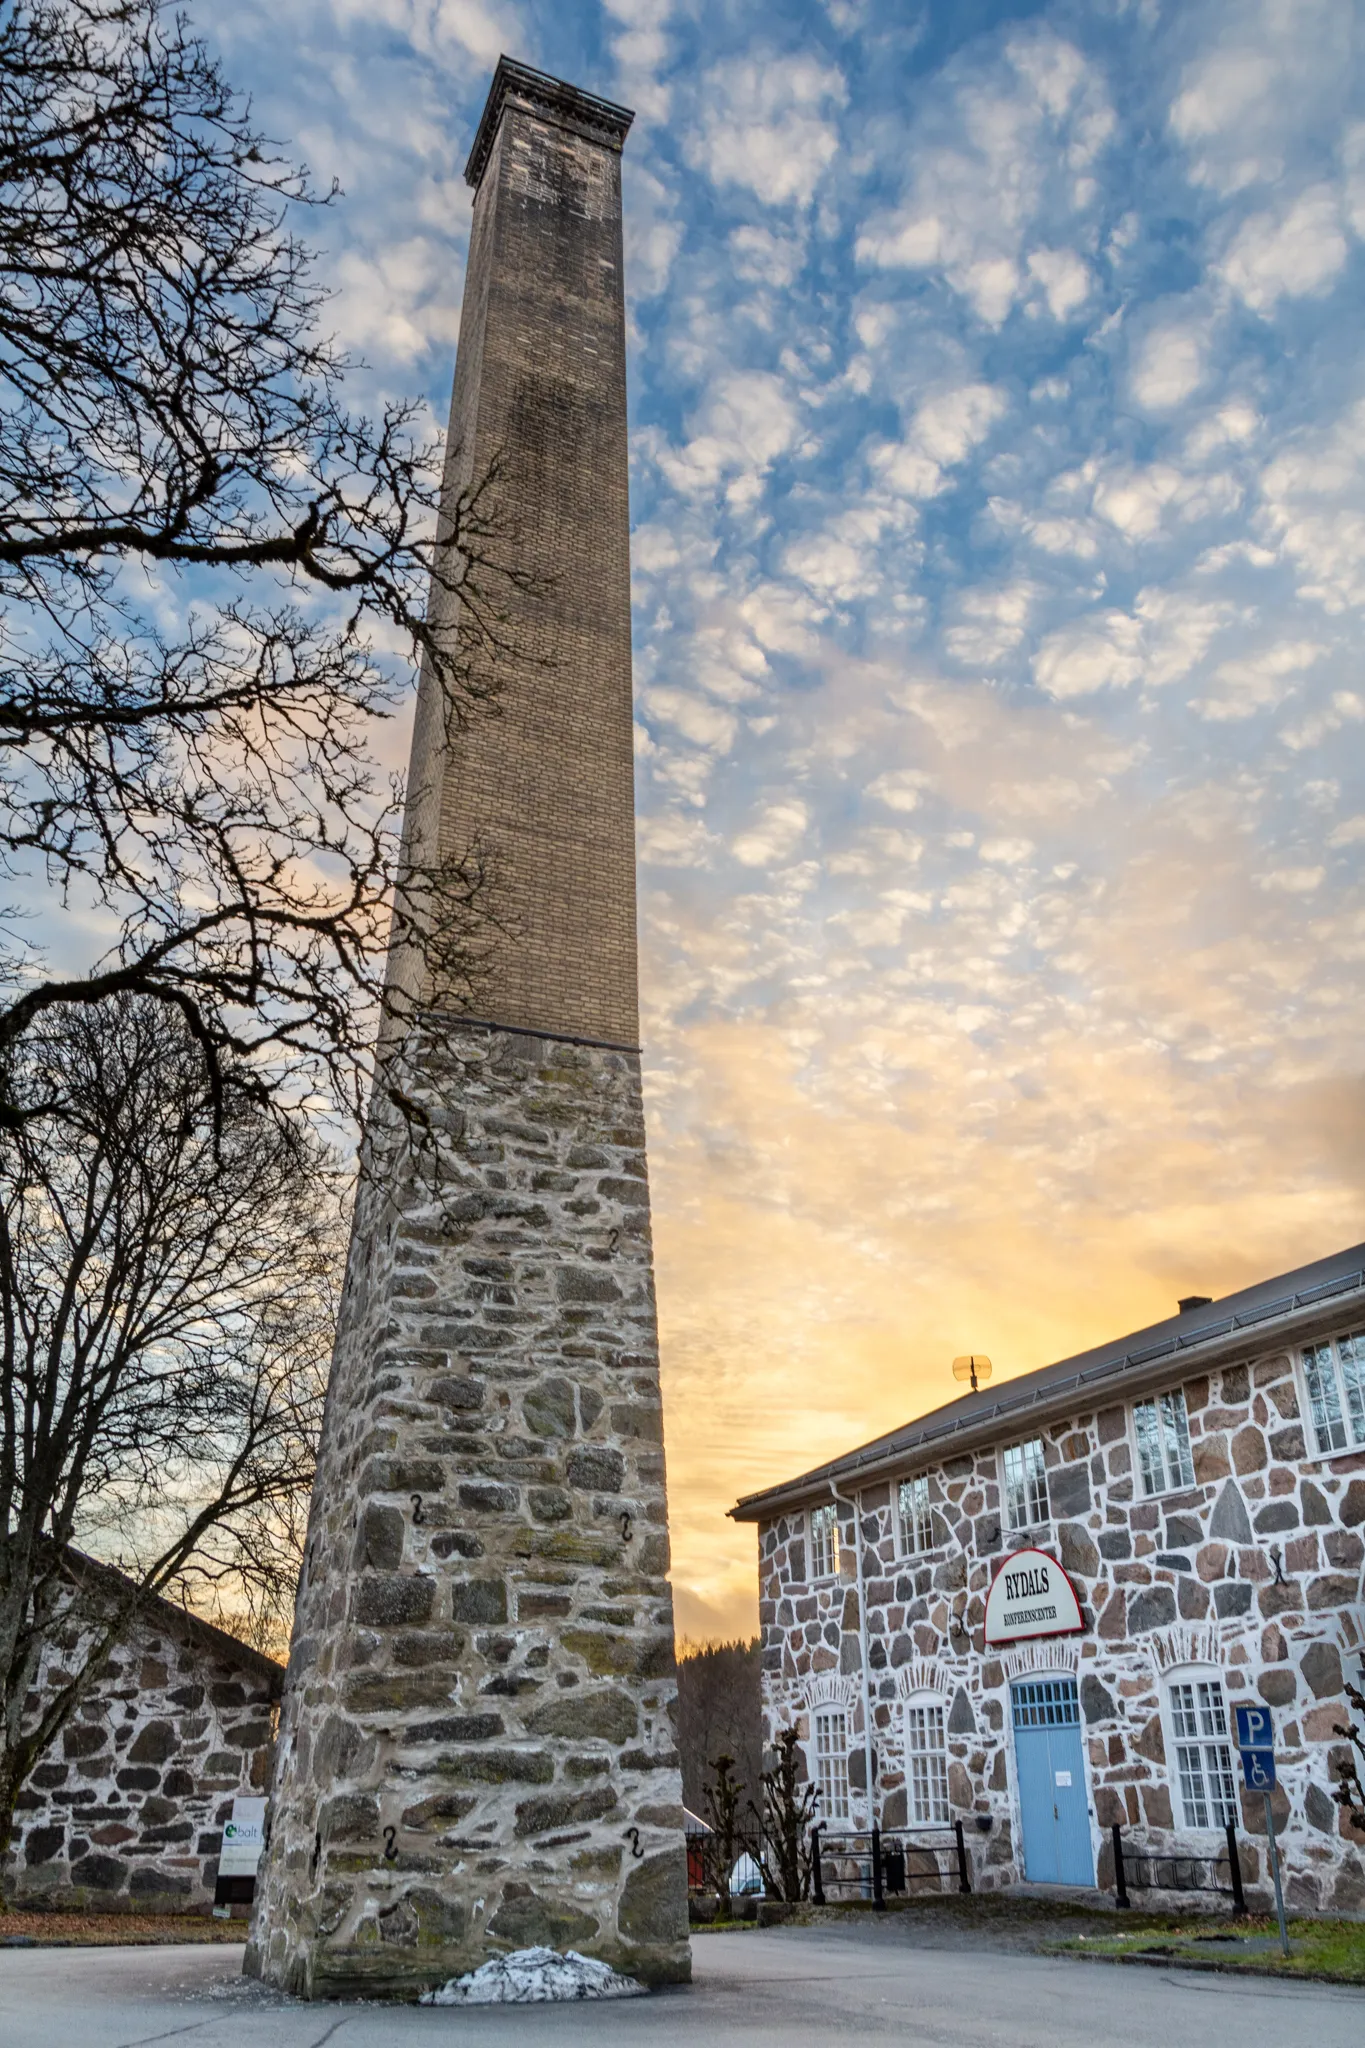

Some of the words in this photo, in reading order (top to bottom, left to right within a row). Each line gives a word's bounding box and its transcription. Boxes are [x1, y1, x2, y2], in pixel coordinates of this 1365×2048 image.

[1005, 1567, 1050, 1600] RYDALS
[1003, 1605, 1057, 1627] KONFERENSCENTER
[1246, 1710, 1264, 1744] P
